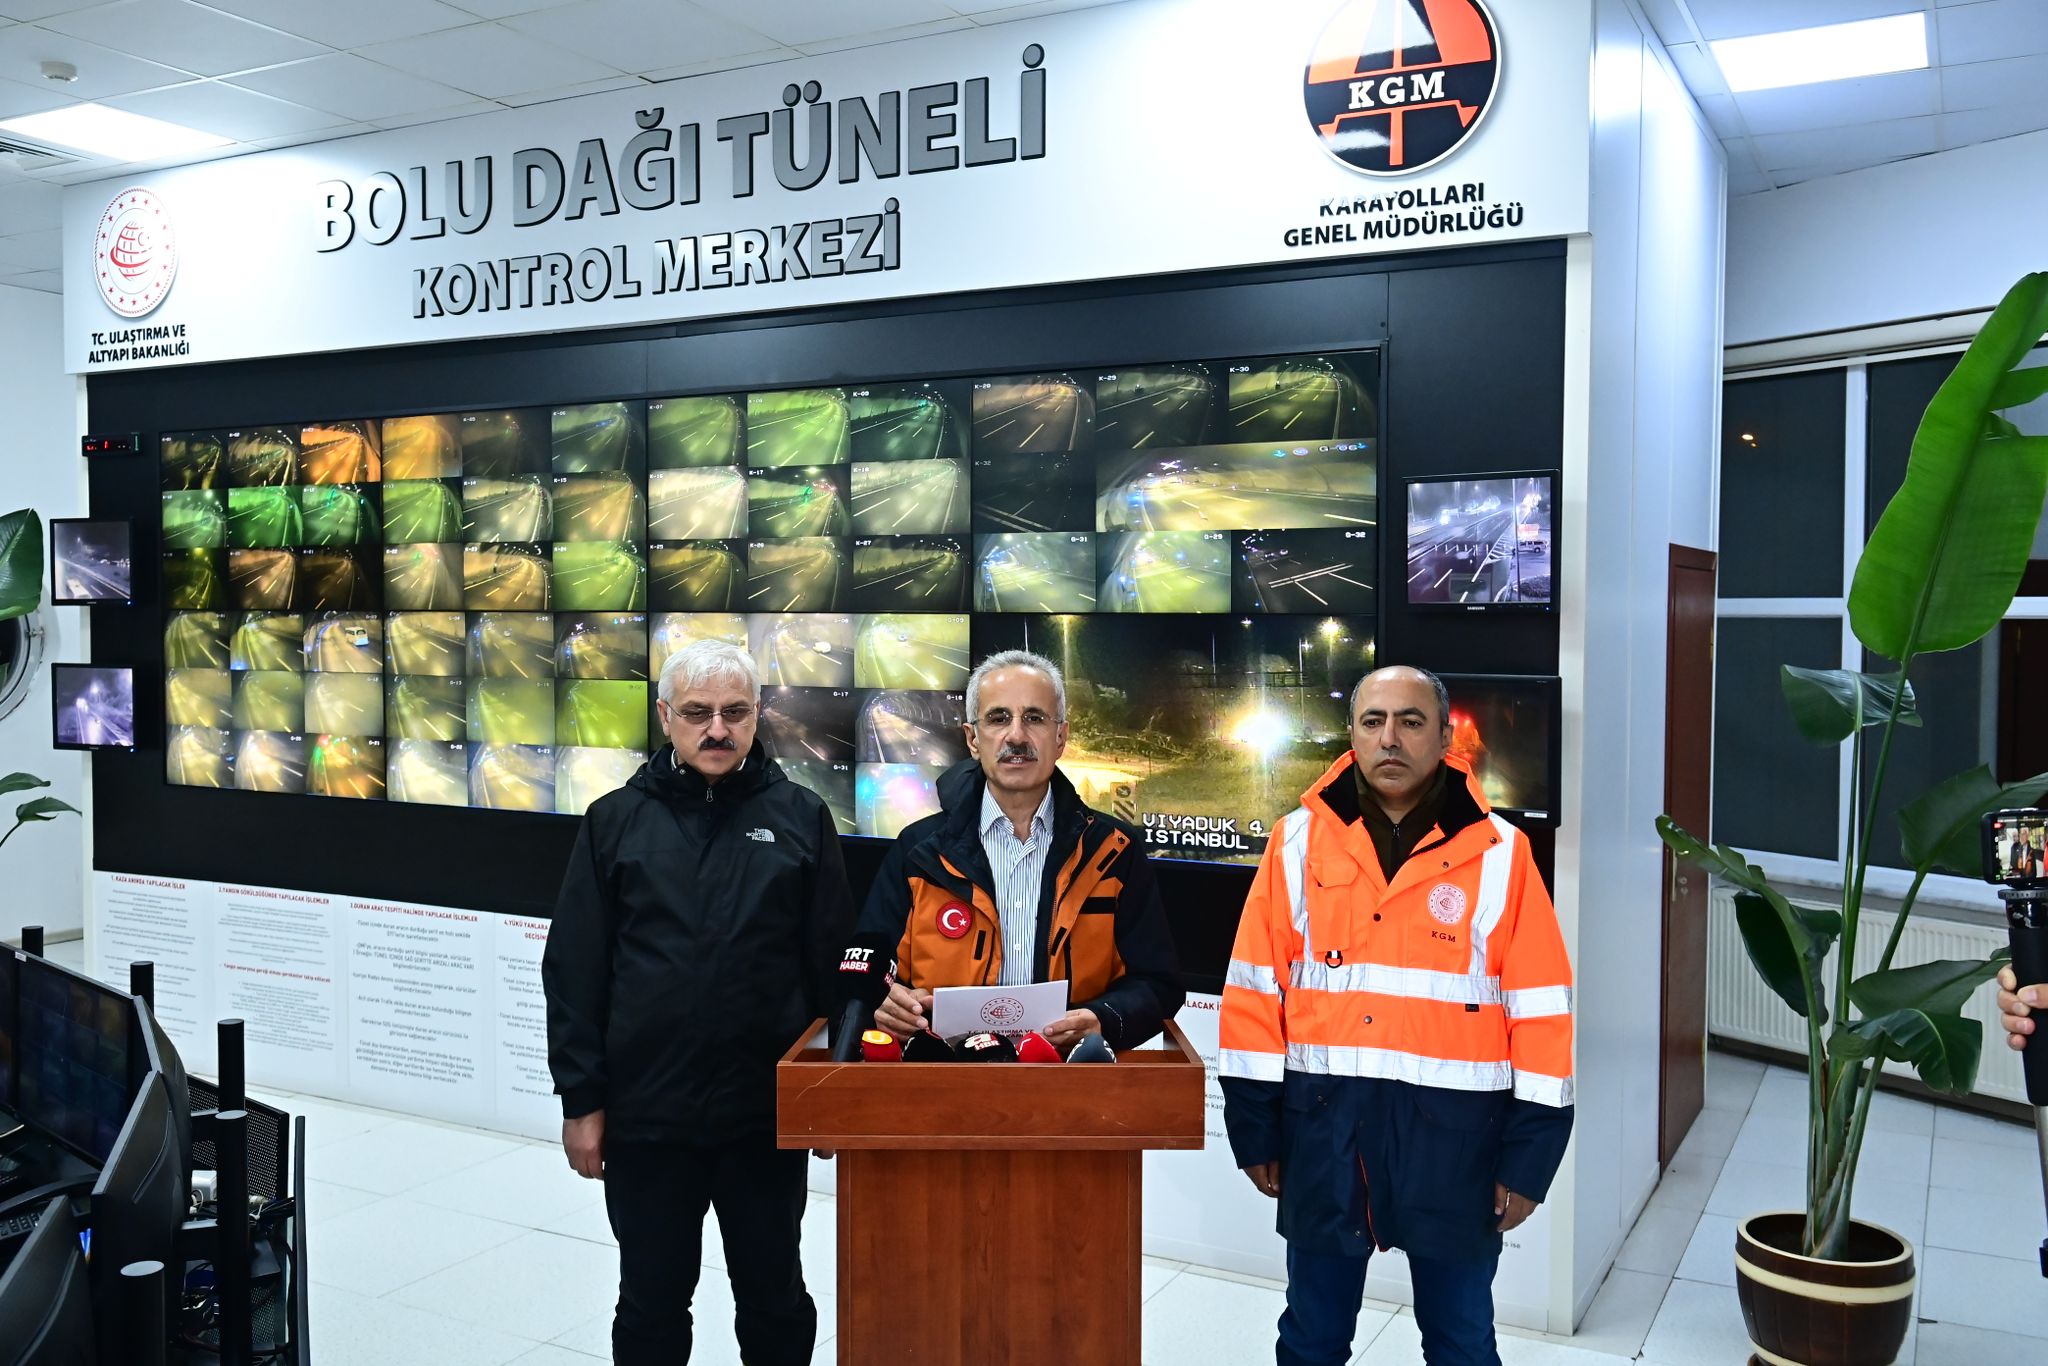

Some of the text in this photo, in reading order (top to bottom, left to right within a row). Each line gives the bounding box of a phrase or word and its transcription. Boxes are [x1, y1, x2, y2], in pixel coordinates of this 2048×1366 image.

[1348, 71, 1445, 109] KGM
[315, 43, 1046, 252] BOLU DAĞI TÜNELİ
[1319, 182, 1485, 217] KARAYOLLARI
[1283, 202, 1524, 247] GENEL MÜDÜRLÜĞÜ
[412, 196, 900, 318] KONTROL MERKEZİ
[109, 326, 170, 346] ULAŞTIRMA
[172, 324, 186, 337] VE
[88, 340, 190, 364] ALTYAPI BAKANLIĞI
[1142, 812, 1263, 834] VIYADUK 4
[1144, 829, 1249, 850] ISTANBUL
[1432, 930, 1456, 942] KGM
[844, 948, 874, 961] TRT
[840, 961, 869, 972] HABER
[1184, 1000, 1214, 1010] ILACAK
